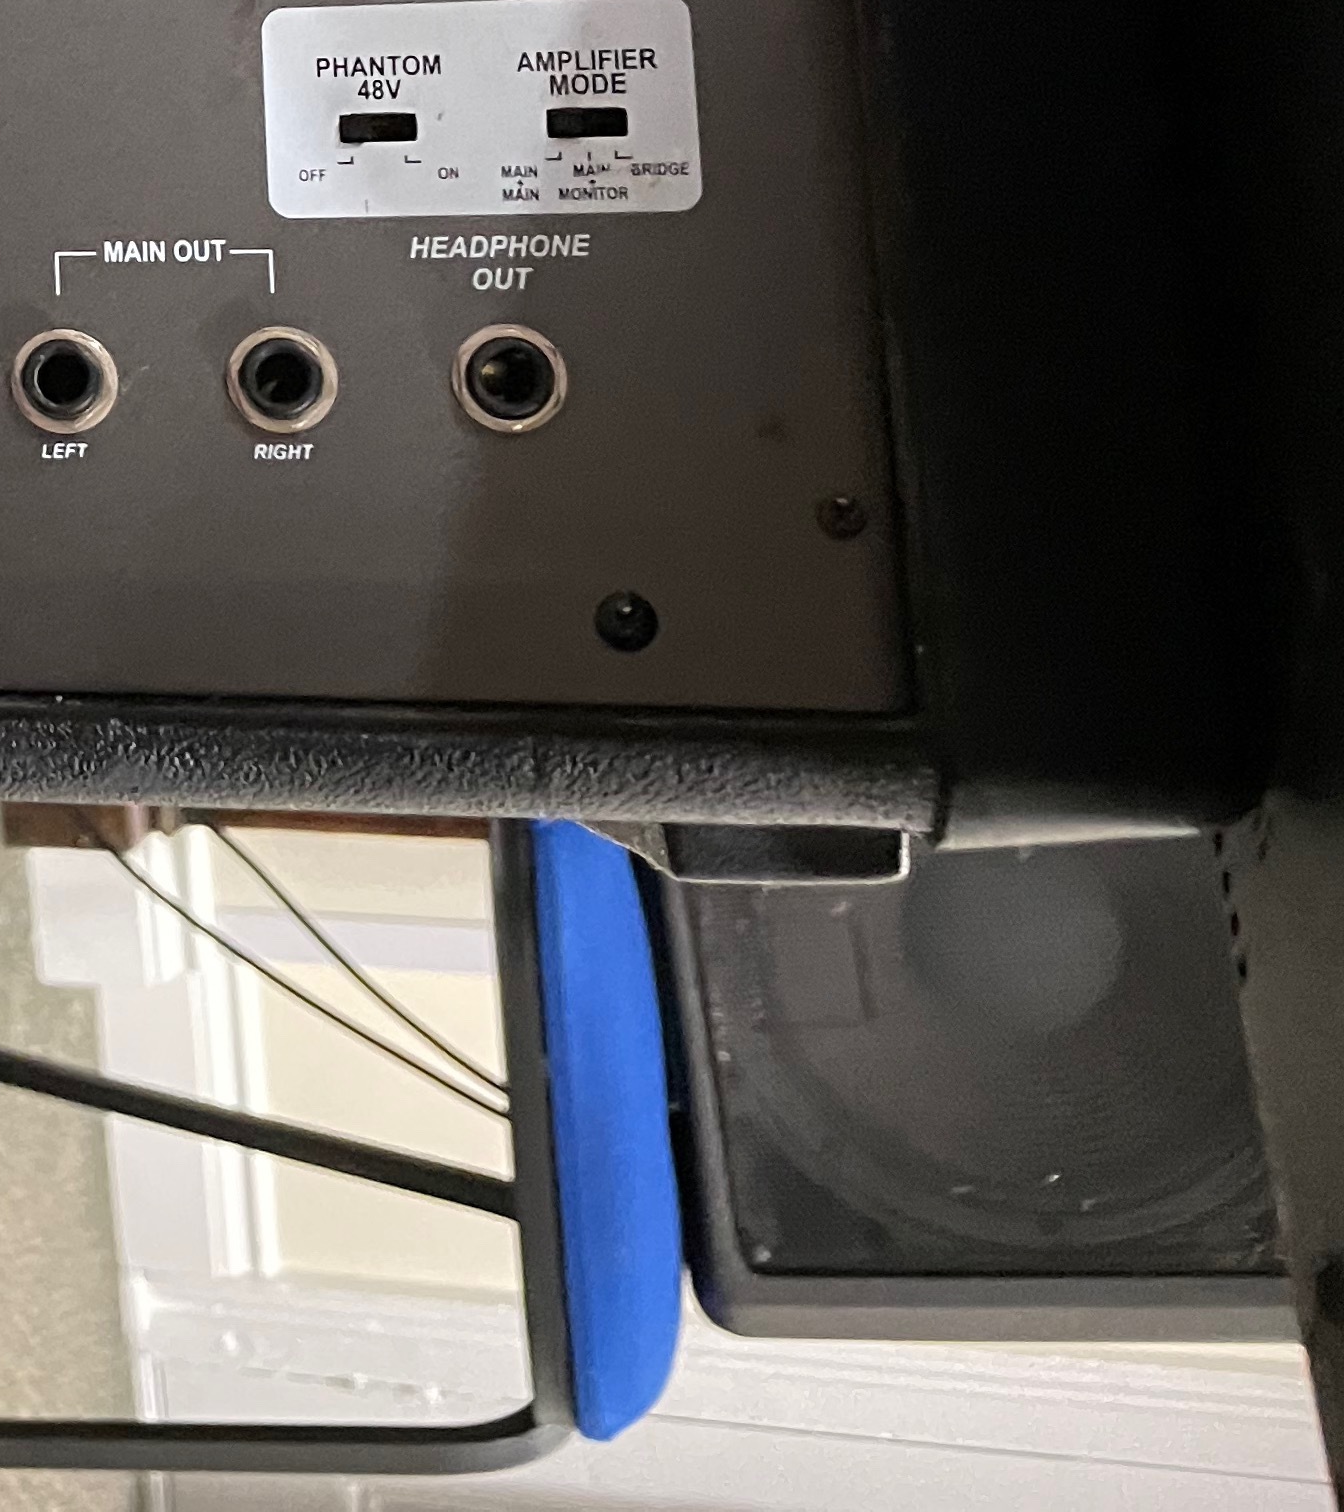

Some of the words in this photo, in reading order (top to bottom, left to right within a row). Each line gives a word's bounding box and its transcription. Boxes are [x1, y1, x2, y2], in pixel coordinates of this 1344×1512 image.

[317, 55, 441, 77] PHANTOM
[518, 49, 657, 72] AMPLIFIER
[358, 80, 400, 99] 48V
[550, 73, 626, 95] MODE
[299, 169, 325, 181] OFF
[438, 168, 459, 179] ON
[502, 166, 537, 177] MAIN
[503, 188, 539, 200] MAIN
[104, 241, 165, 262] MAIN
[174, 240, 226, 262] OUT
[410, 234, 589, 258] HEADPHONE
[473, 268, 533, 290] OUT
[42, 443, 88, 458] LEFT
[254, 444, 313, 459] RIGHT
